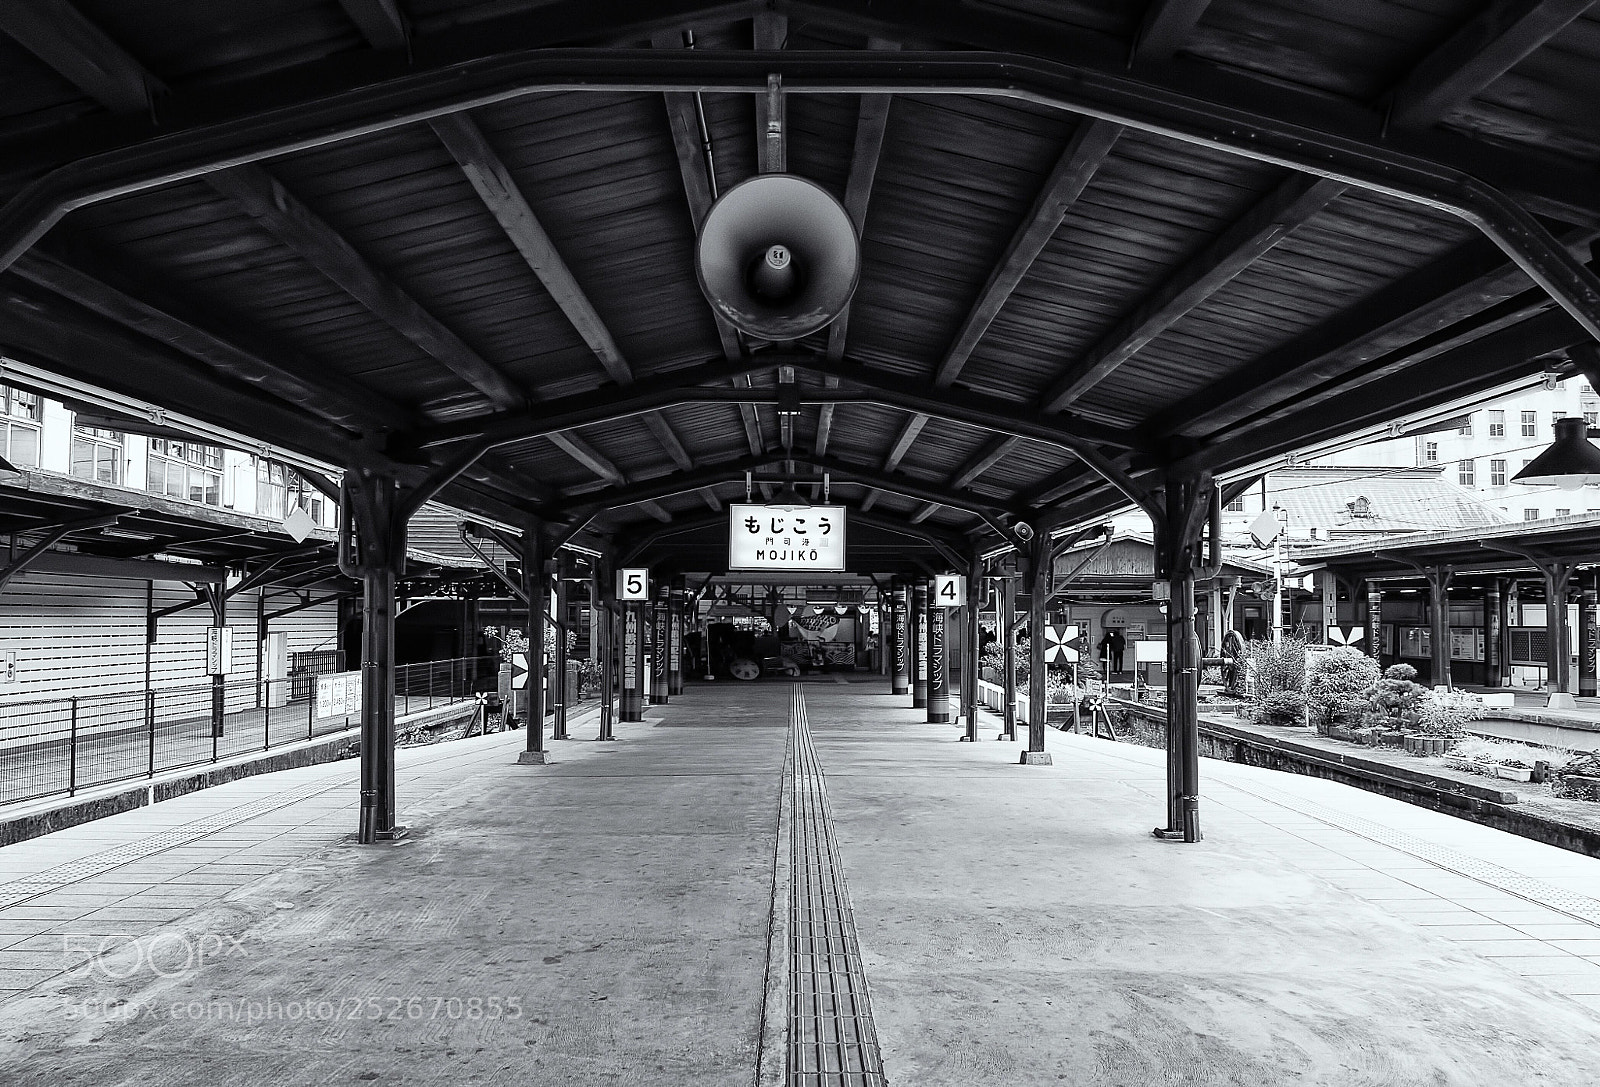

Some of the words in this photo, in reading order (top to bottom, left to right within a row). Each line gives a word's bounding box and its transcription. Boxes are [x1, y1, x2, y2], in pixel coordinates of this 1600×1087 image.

[744, 515, 831, 535] もじこう
[627, 574, 643, 595] 5
[940, 580, 957, 600] 4
